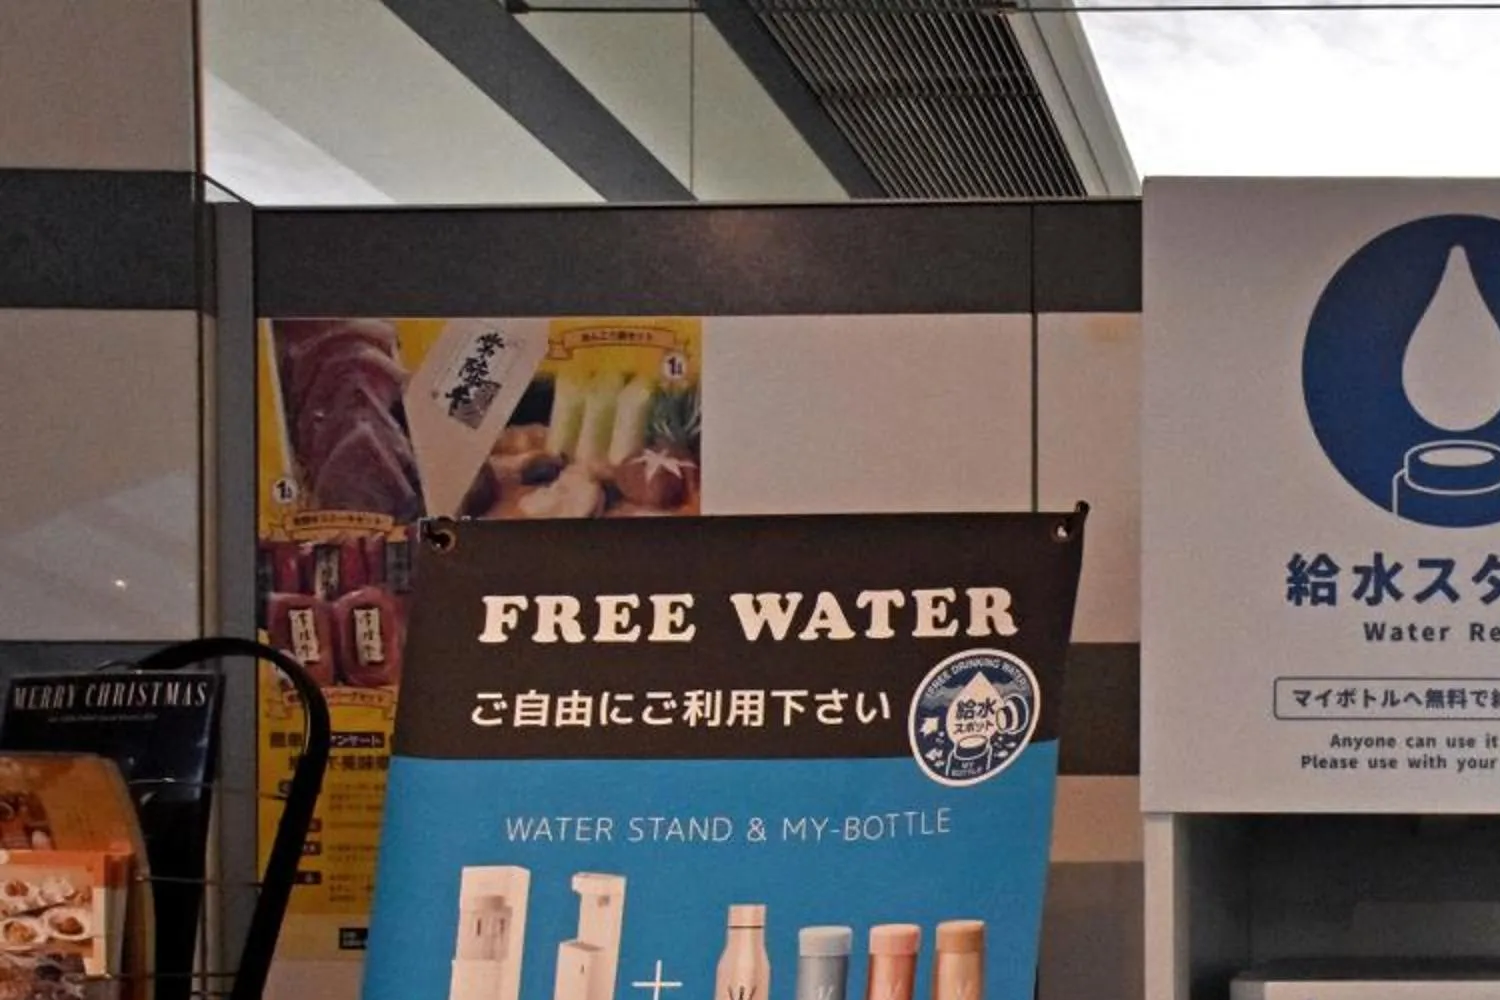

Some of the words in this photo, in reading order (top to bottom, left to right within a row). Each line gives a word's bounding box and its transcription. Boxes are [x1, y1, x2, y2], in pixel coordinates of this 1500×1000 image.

[478, 593, 696, 643] FREE
[730, 587, 1018, 641] WATER
[1363, 622, 1450, 642] Water
[84, 682, 208, 707] CHRISTMAS
[472, 689, 890, 727] ご自由にご利用下さい
[955, 697, 997, 720] 給水
[1330, 734, 1396, 751] Anyone
[1406, 737, 1436, 748] can
[1446, 737, 1476, 748] use
[1485, 733, 1498, 749] it
[1301, 755, 1358, 769] Please
[1368, 758, 1398, 769] use
[1408, 754, 1447, 769] with
[1457, 758, 1497, 773] your
[507, 817, 613, 842] WATER
[628, 817, 732, 842] STAND
[747, 817, 766, 841] &
[782, 808, 950, 841] MY-BOTTLE
